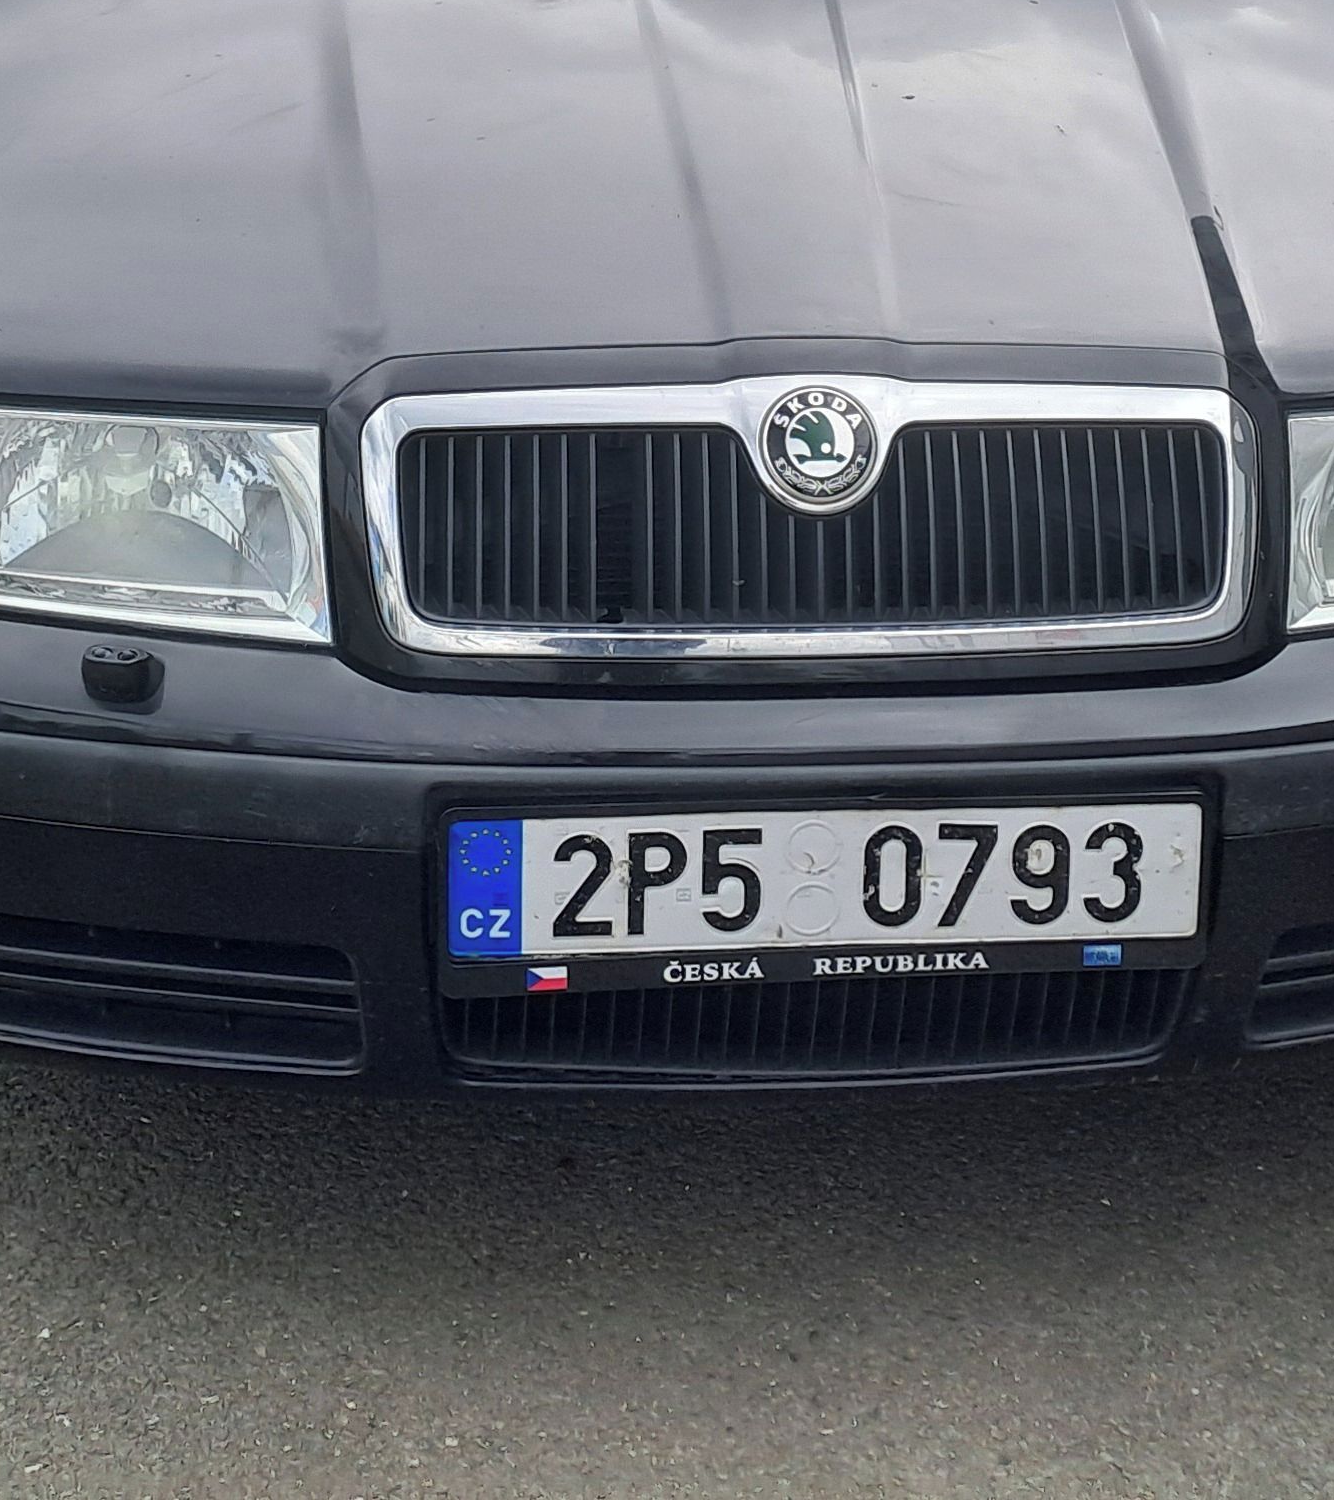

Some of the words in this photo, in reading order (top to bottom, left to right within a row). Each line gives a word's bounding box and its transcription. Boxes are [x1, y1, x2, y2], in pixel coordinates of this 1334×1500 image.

[552, 827, 763, 938] 2P5
[863, 820, 1144, 928] 0793
[459, 907, 512, 939] CZ
[663, 956, 765, 983] ČESKÁ
[813, 951, 990, 976] REPUBLIKA
